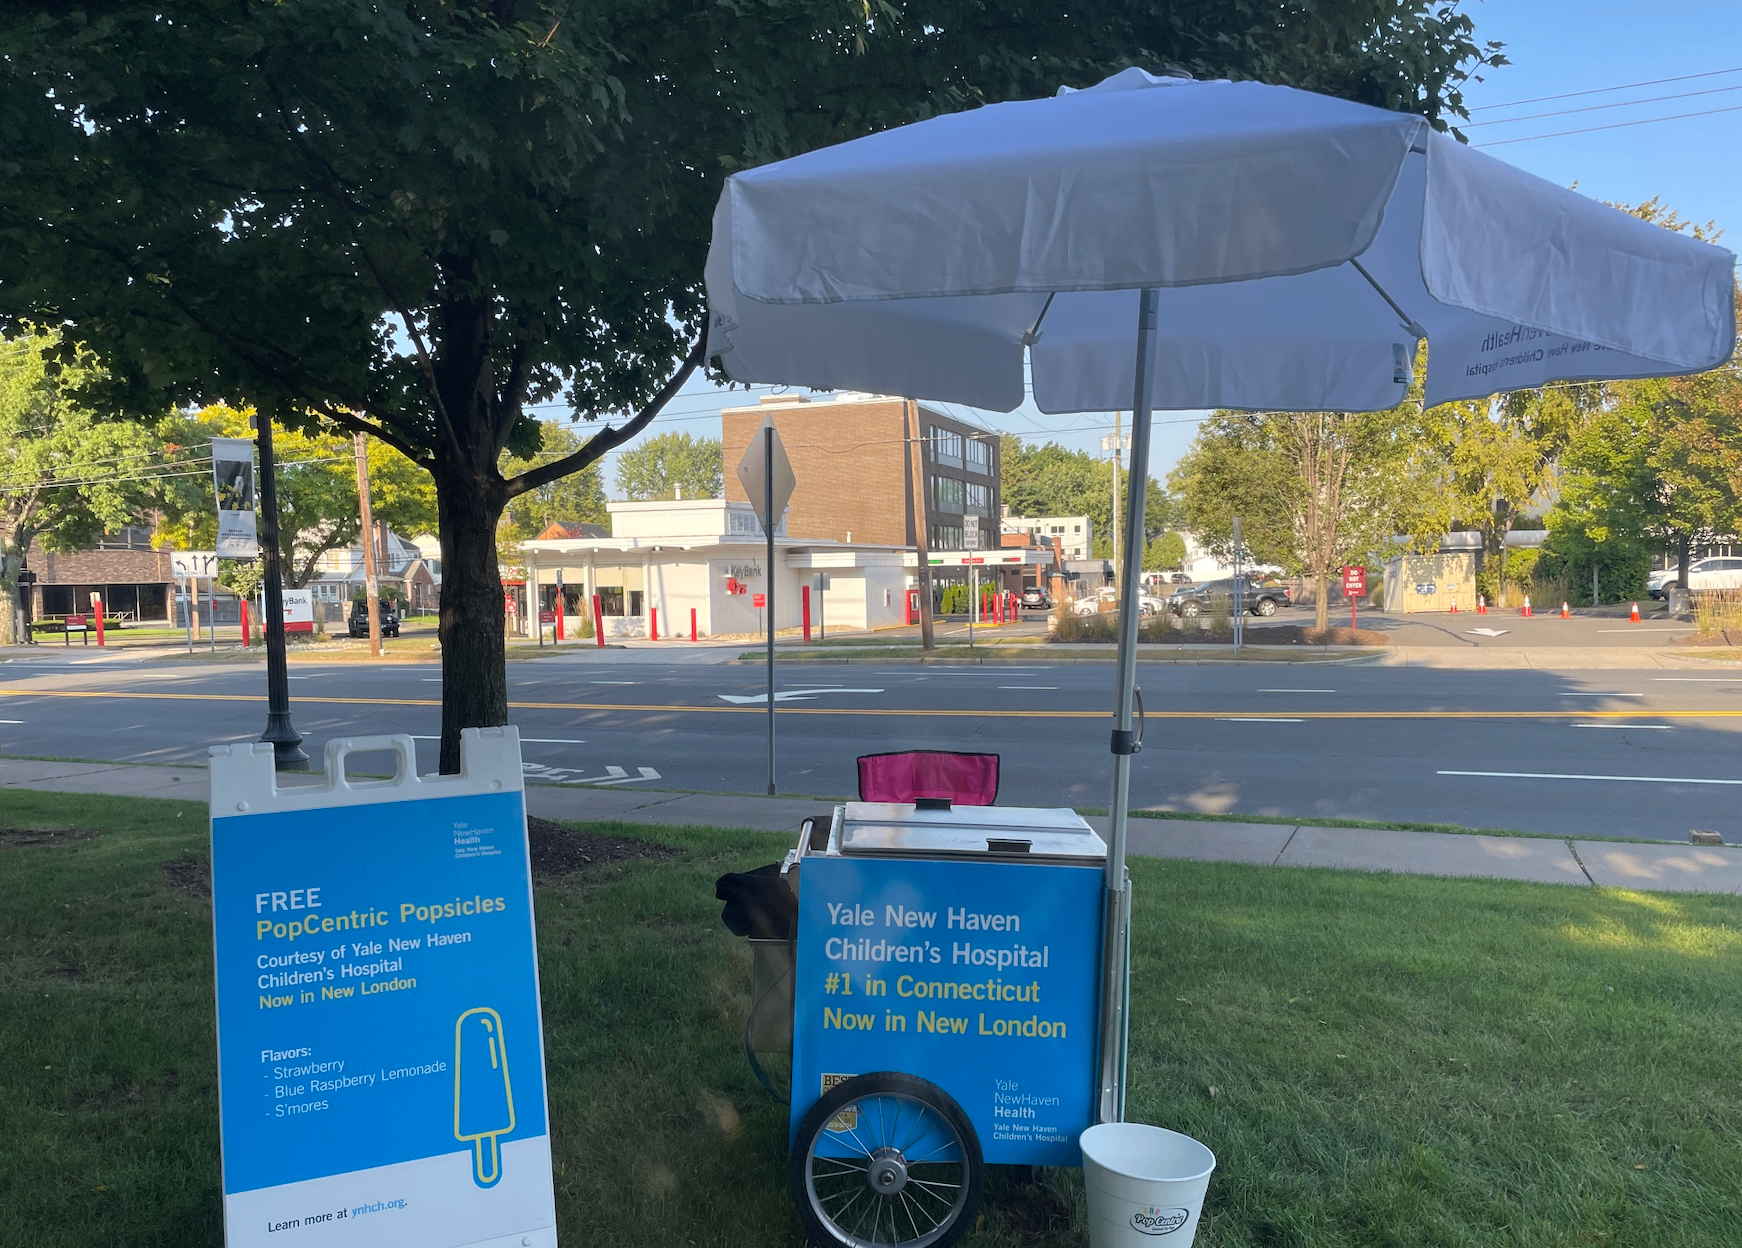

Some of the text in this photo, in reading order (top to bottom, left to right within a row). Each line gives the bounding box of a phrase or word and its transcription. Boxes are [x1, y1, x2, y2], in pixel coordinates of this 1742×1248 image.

[964, 530, 978, 538] BLOCK
[731, 565, 762, 579] KeyBank
[282, 596, 308, 606] eyBank
[454, 828, 494, 836] NewHaven
[454, 836, 480, 845] Health
[256, 887, 322, 914] FREE
[256, 895, 506, 941] PopCentric Popsicles
[827, 902, 1020, 932] Yale New Haven
[257, 930, 472, 969] Courtesy of Yale New Haven
[952, 942, 1048, 971] Hospital
[341, 958, 403, 980] Hospital
[260, 974, 417, 1010] Now in New London
[825, 973, 1040, 1002] #1 in Connecticut
[824, 1007, 1066, 1038] Now in New London
[261, 1047, 312, 1063] Flavors:
[274, 1059, 345, 1080] Strawberry
[275, 1084, 305, 1099] Blue
[310, 1073, 376, 1093] Raspberry
[382, 1060, 447, 1082] Lemonade
[994, 1078, 1018, 1091] Yale
[994, 1092, 1060, 1106] NewHaven
[994, 1106, 1035, 1118] Health
[994, 1123, 1010, 1131] Yale
[1033, 1124, 1057, 1132] Haven
[1036, 1134, 1067, 1143] Hospital
[268, 1198, 408, 1232] Learn more at ynhch.org.
